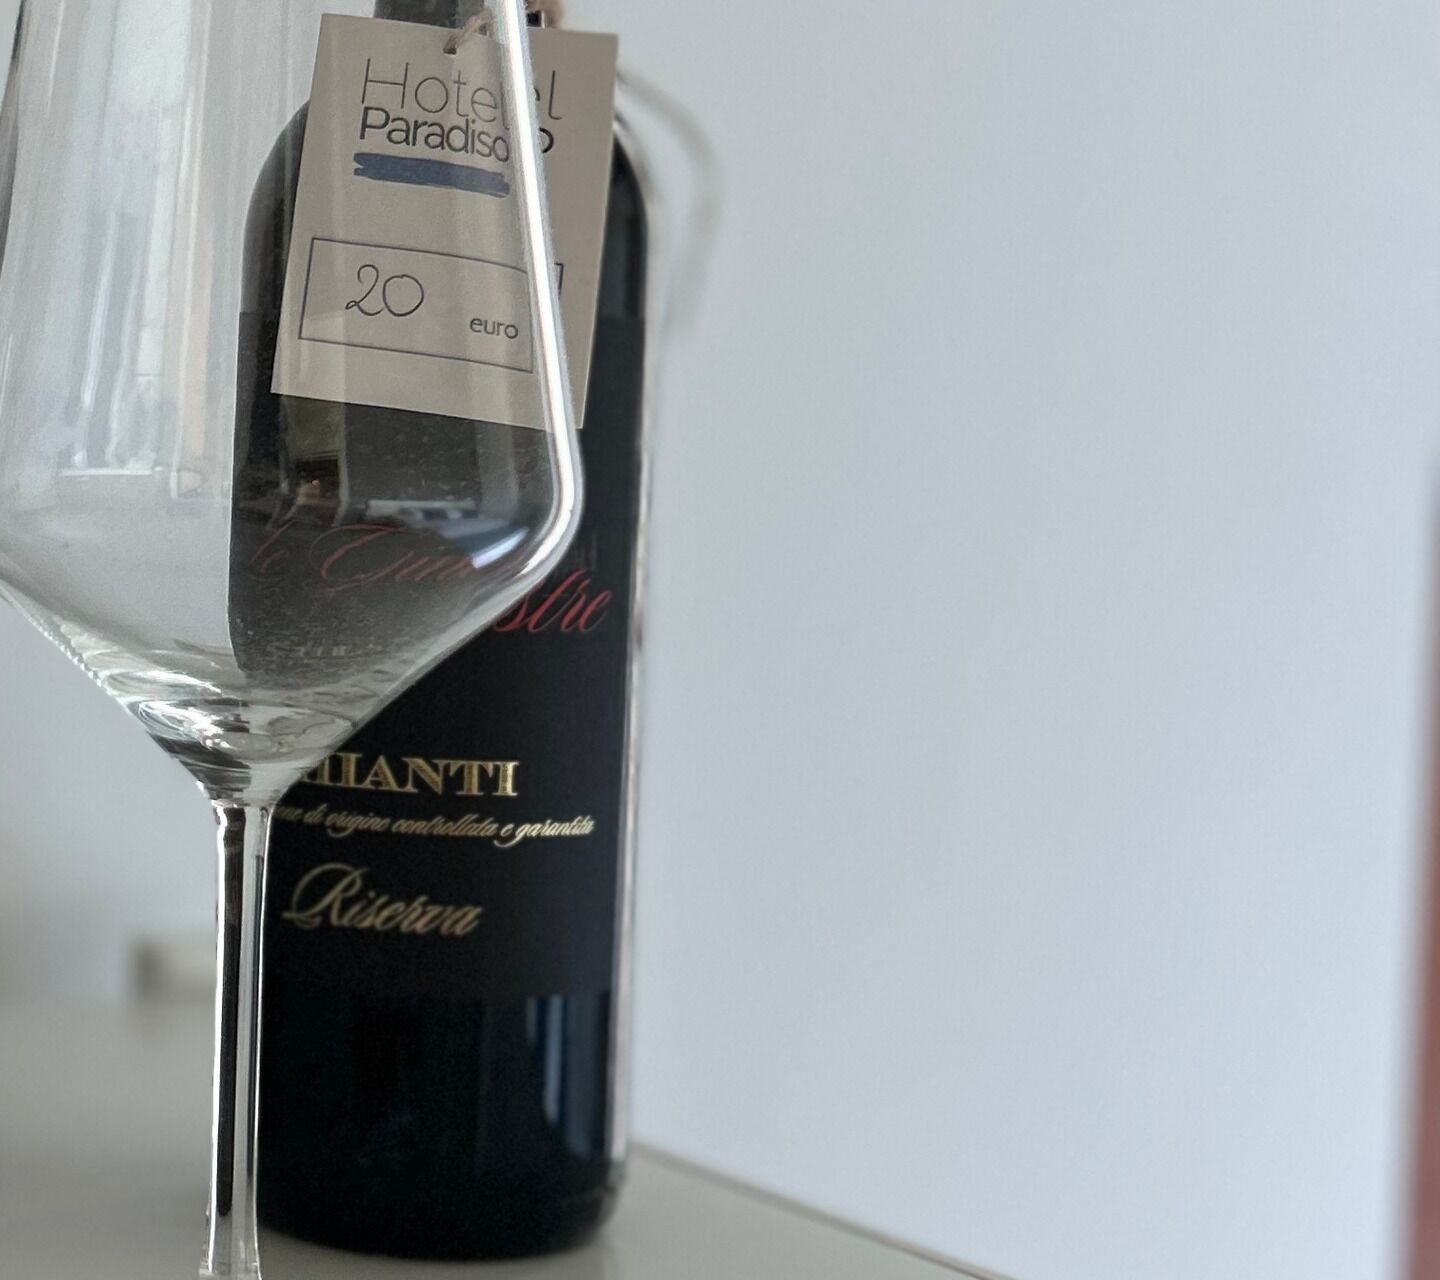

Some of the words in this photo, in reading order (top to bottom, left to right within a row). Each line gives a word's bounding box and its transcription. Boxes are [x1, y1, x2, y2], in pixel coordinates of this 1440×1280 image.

[361, 58, 510, 131] Hotel
[359, 106, 510, 163] Paradiso
[345, 264, 424, 317] 20
[469, 317, 519, 339] euro
[298, 752, 519, 797] HIANTI
[391, 813, 498, 838] controllata
[493, 814, 595, 848] garantita
[282, 862, 482, 936] Riserva
